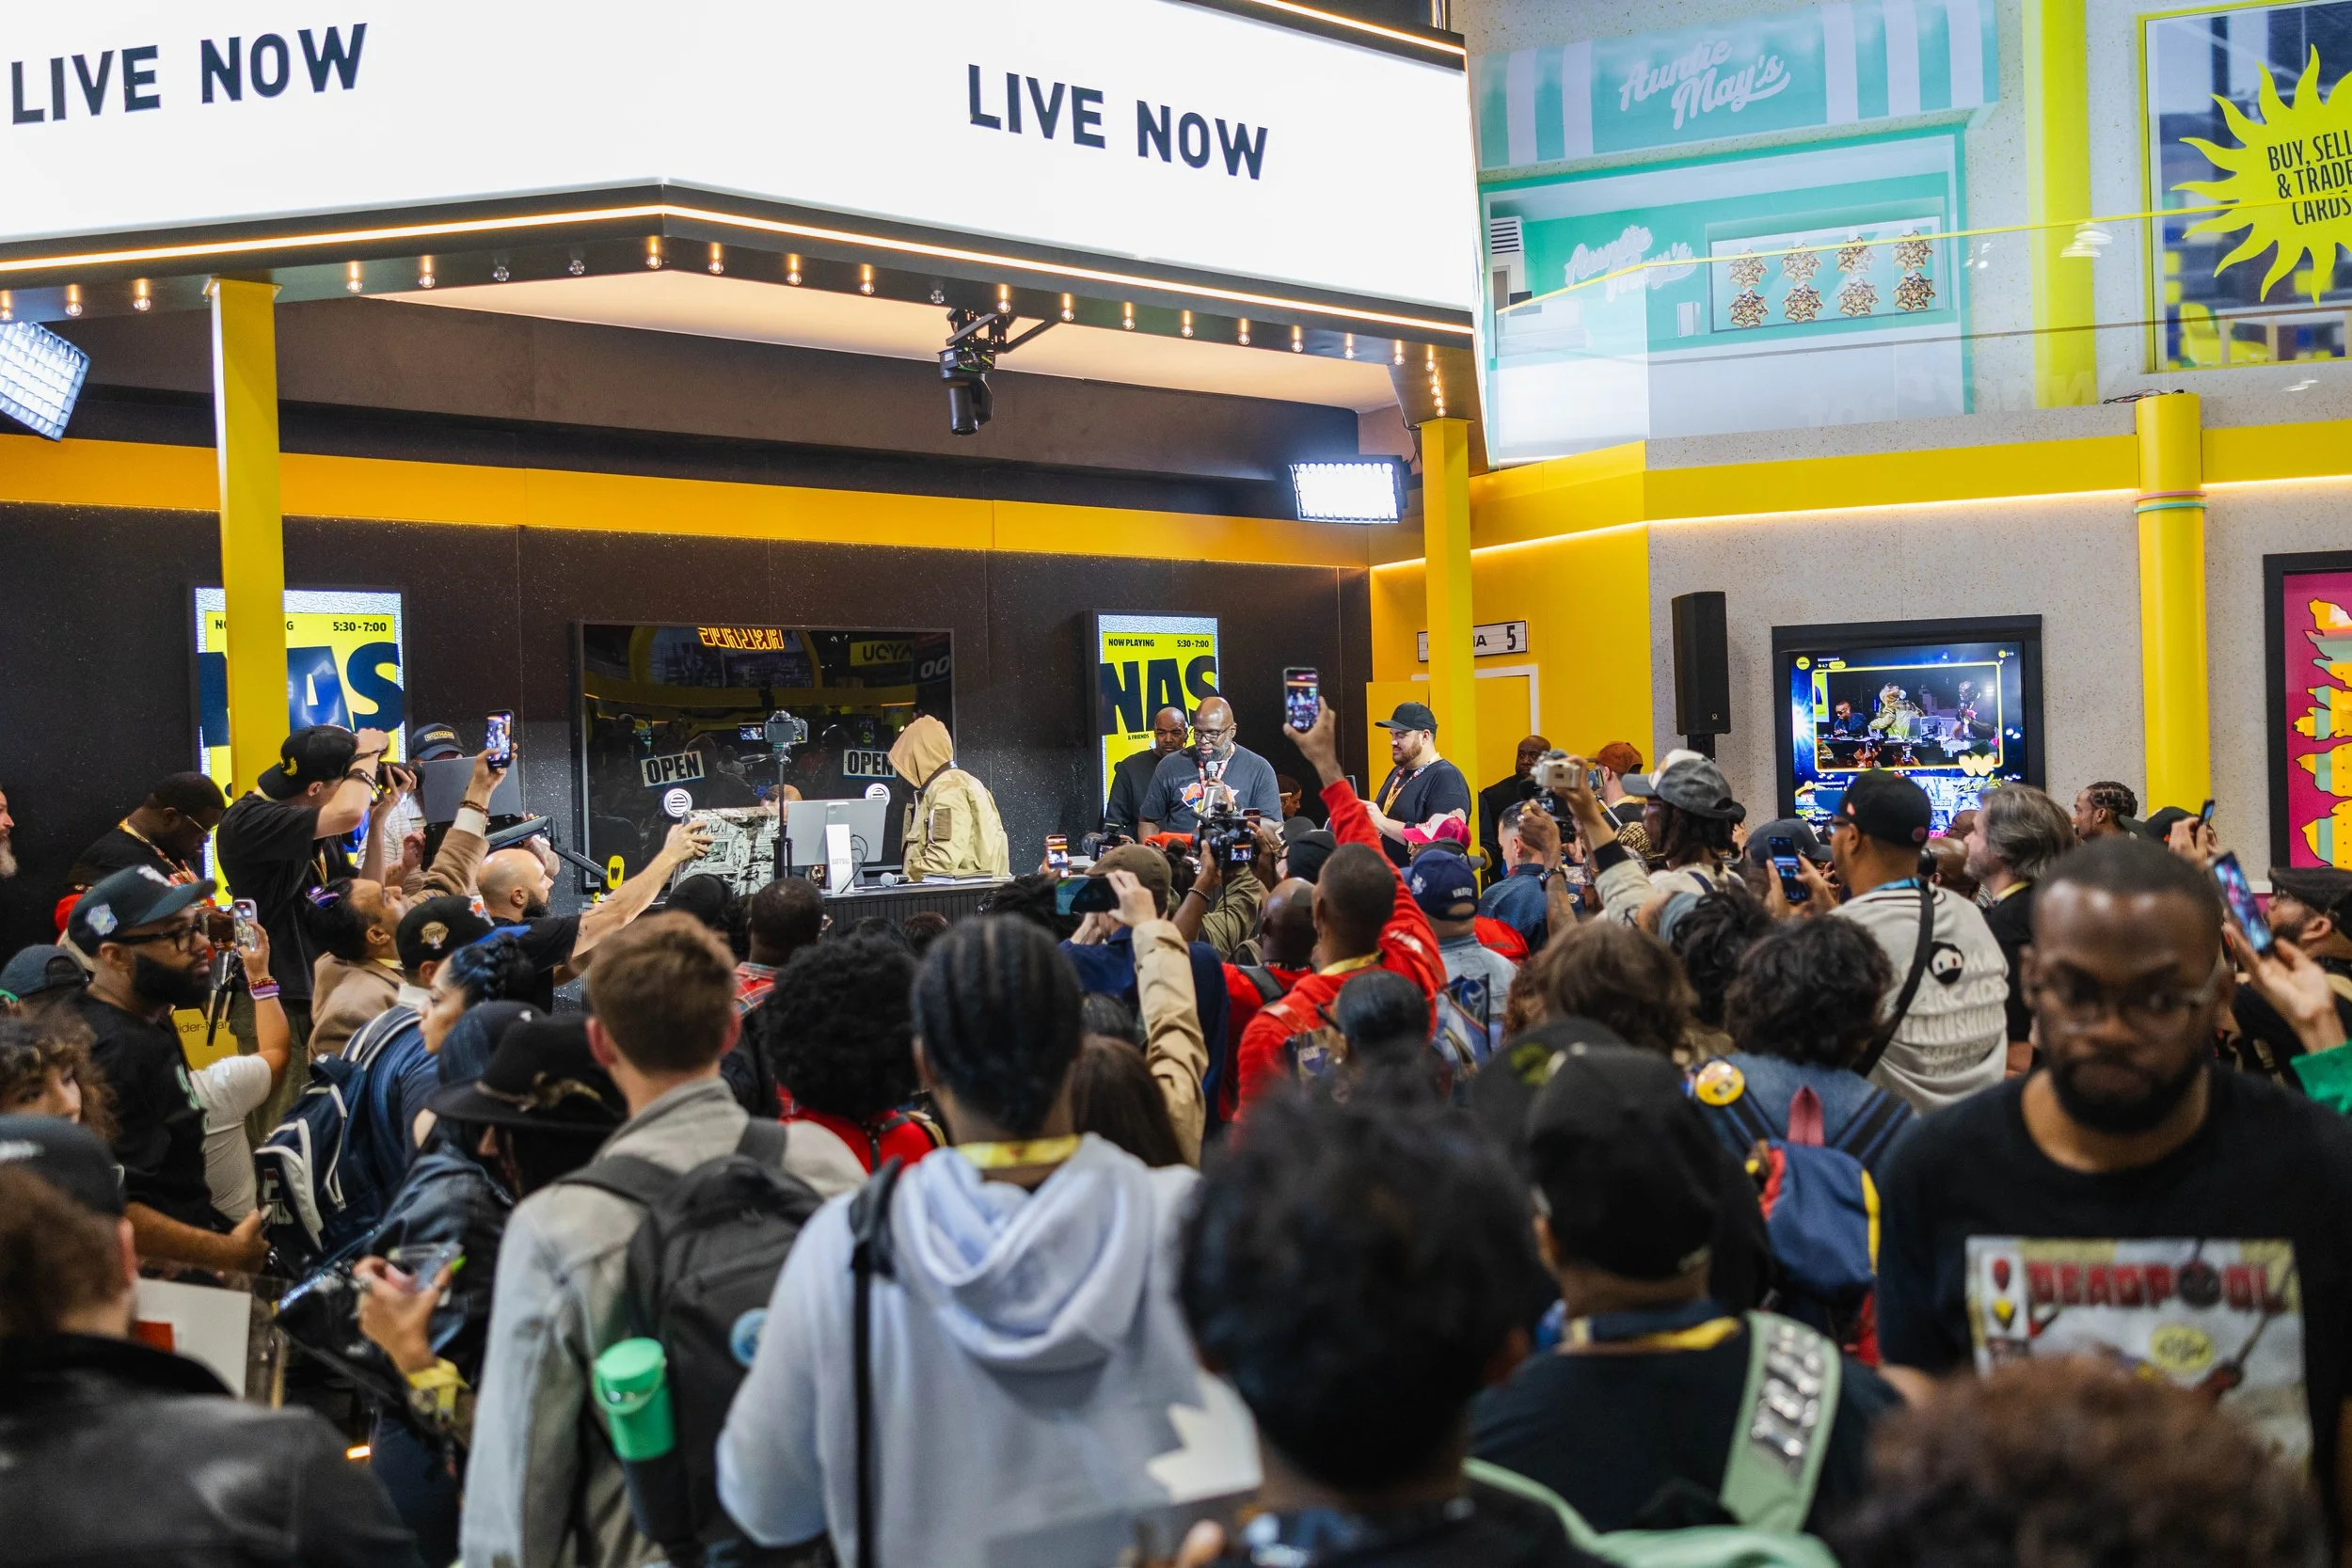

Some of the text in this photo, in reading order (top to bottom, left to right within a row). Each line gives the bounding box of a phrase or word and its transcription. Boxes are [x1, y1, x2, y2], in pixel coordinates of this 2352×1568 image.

[12, 23, 368, 125] LIVE NOW
[1618, 40, 1733, 111] Auntie
[1671, 55, 1791, 131] May's
[968, 63, 1268, 181] LIVE NOW
[2266, 139, 2312, 172] BUY,
[2277, 173, 2293, 199] &
[2292, 190, 2352, 226] CARDS
[333, 621, 357, 632] 5:30
[363, 622, 387, 632] 7:00
[1506, 625, 1517, 651] 5
[1108, 639, 1125, 647] NOW
[1125, 639, 1155, 647] PLAYING
[1177, 640, 1191, 648] 5:30
[1195, 640, 1210, 648] 7:00
[645, 752, 701, 784] OPEN
[847, 752, 893, 776] OPEN
